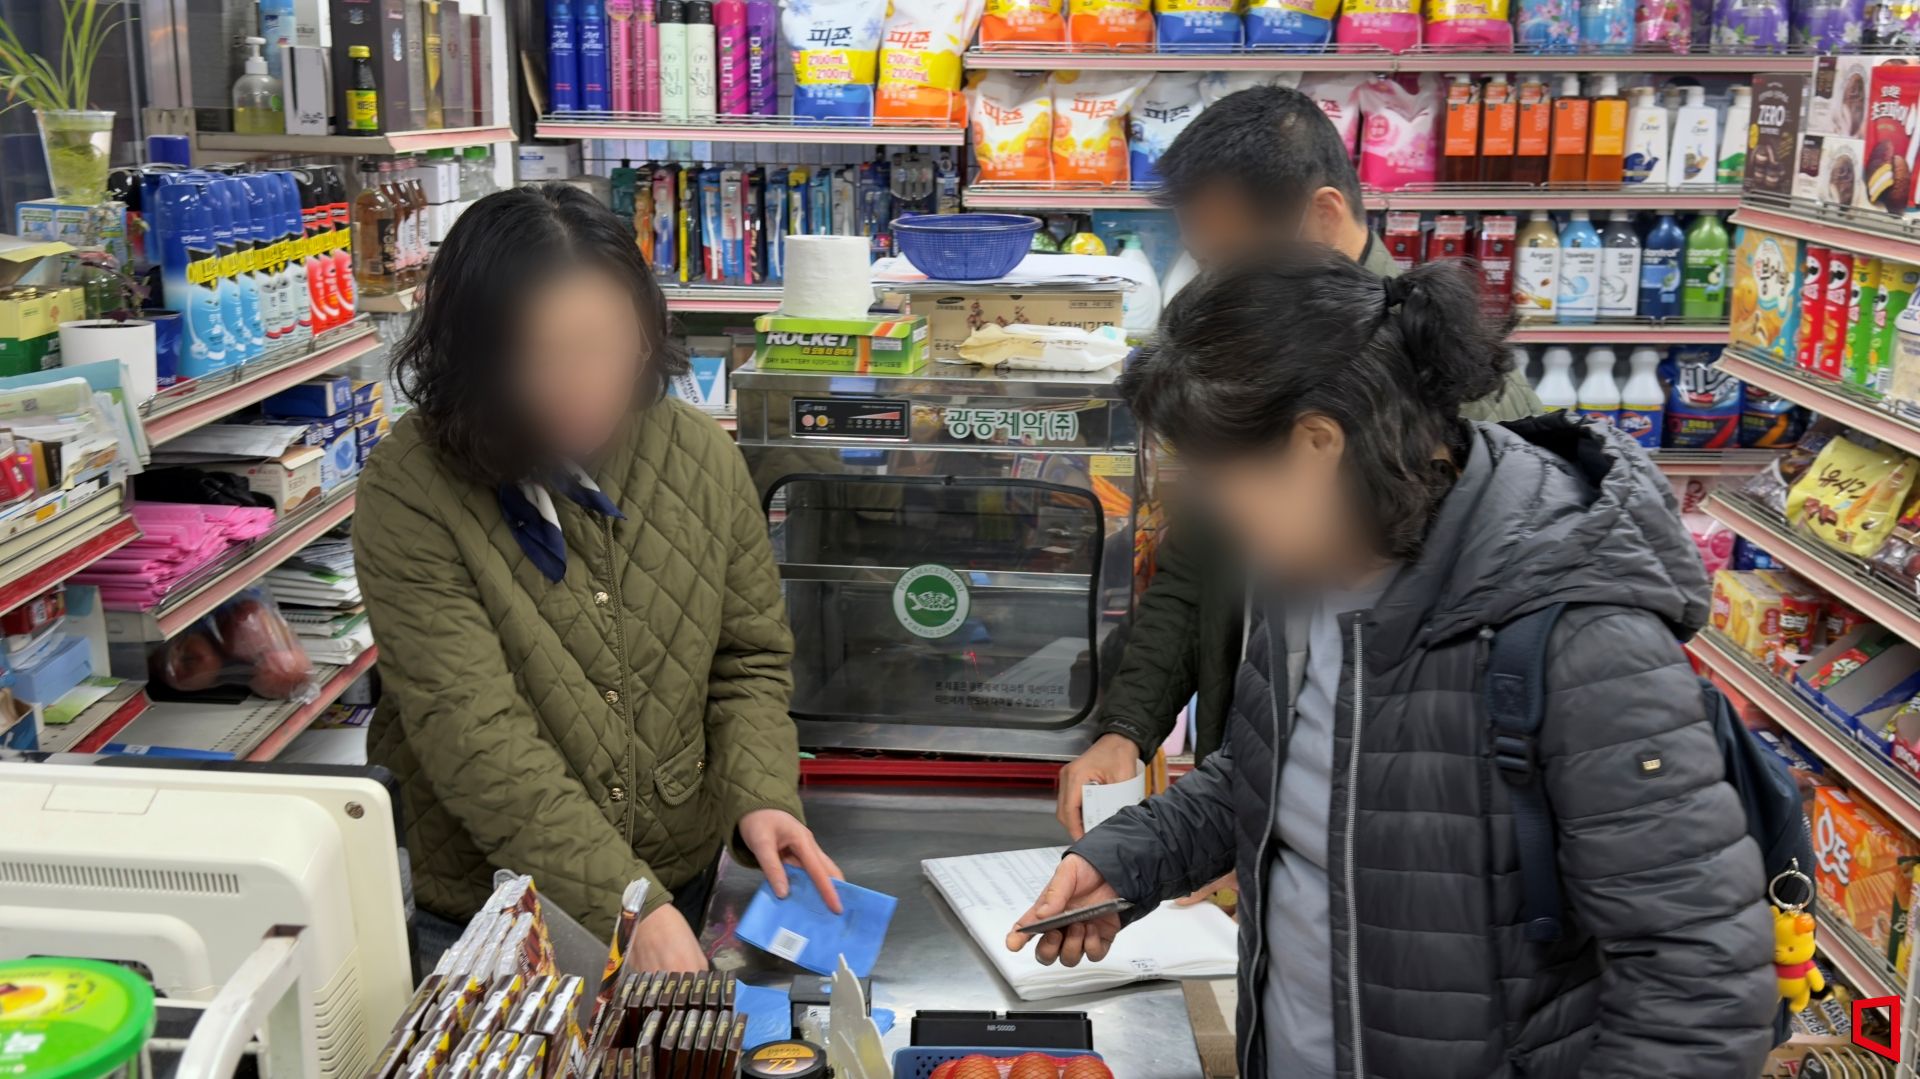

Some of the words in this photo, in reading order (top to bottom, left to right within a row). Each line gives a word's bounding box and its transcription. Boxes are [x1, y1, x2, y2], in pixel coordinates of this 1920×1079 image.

[1757, 105, 1785, 127] ZERO
[766, 332, 850, 347] ROCKET
[948, 409, 1078, 441] 광동제약(주)
[766, 1058, 798, 1072] 72
